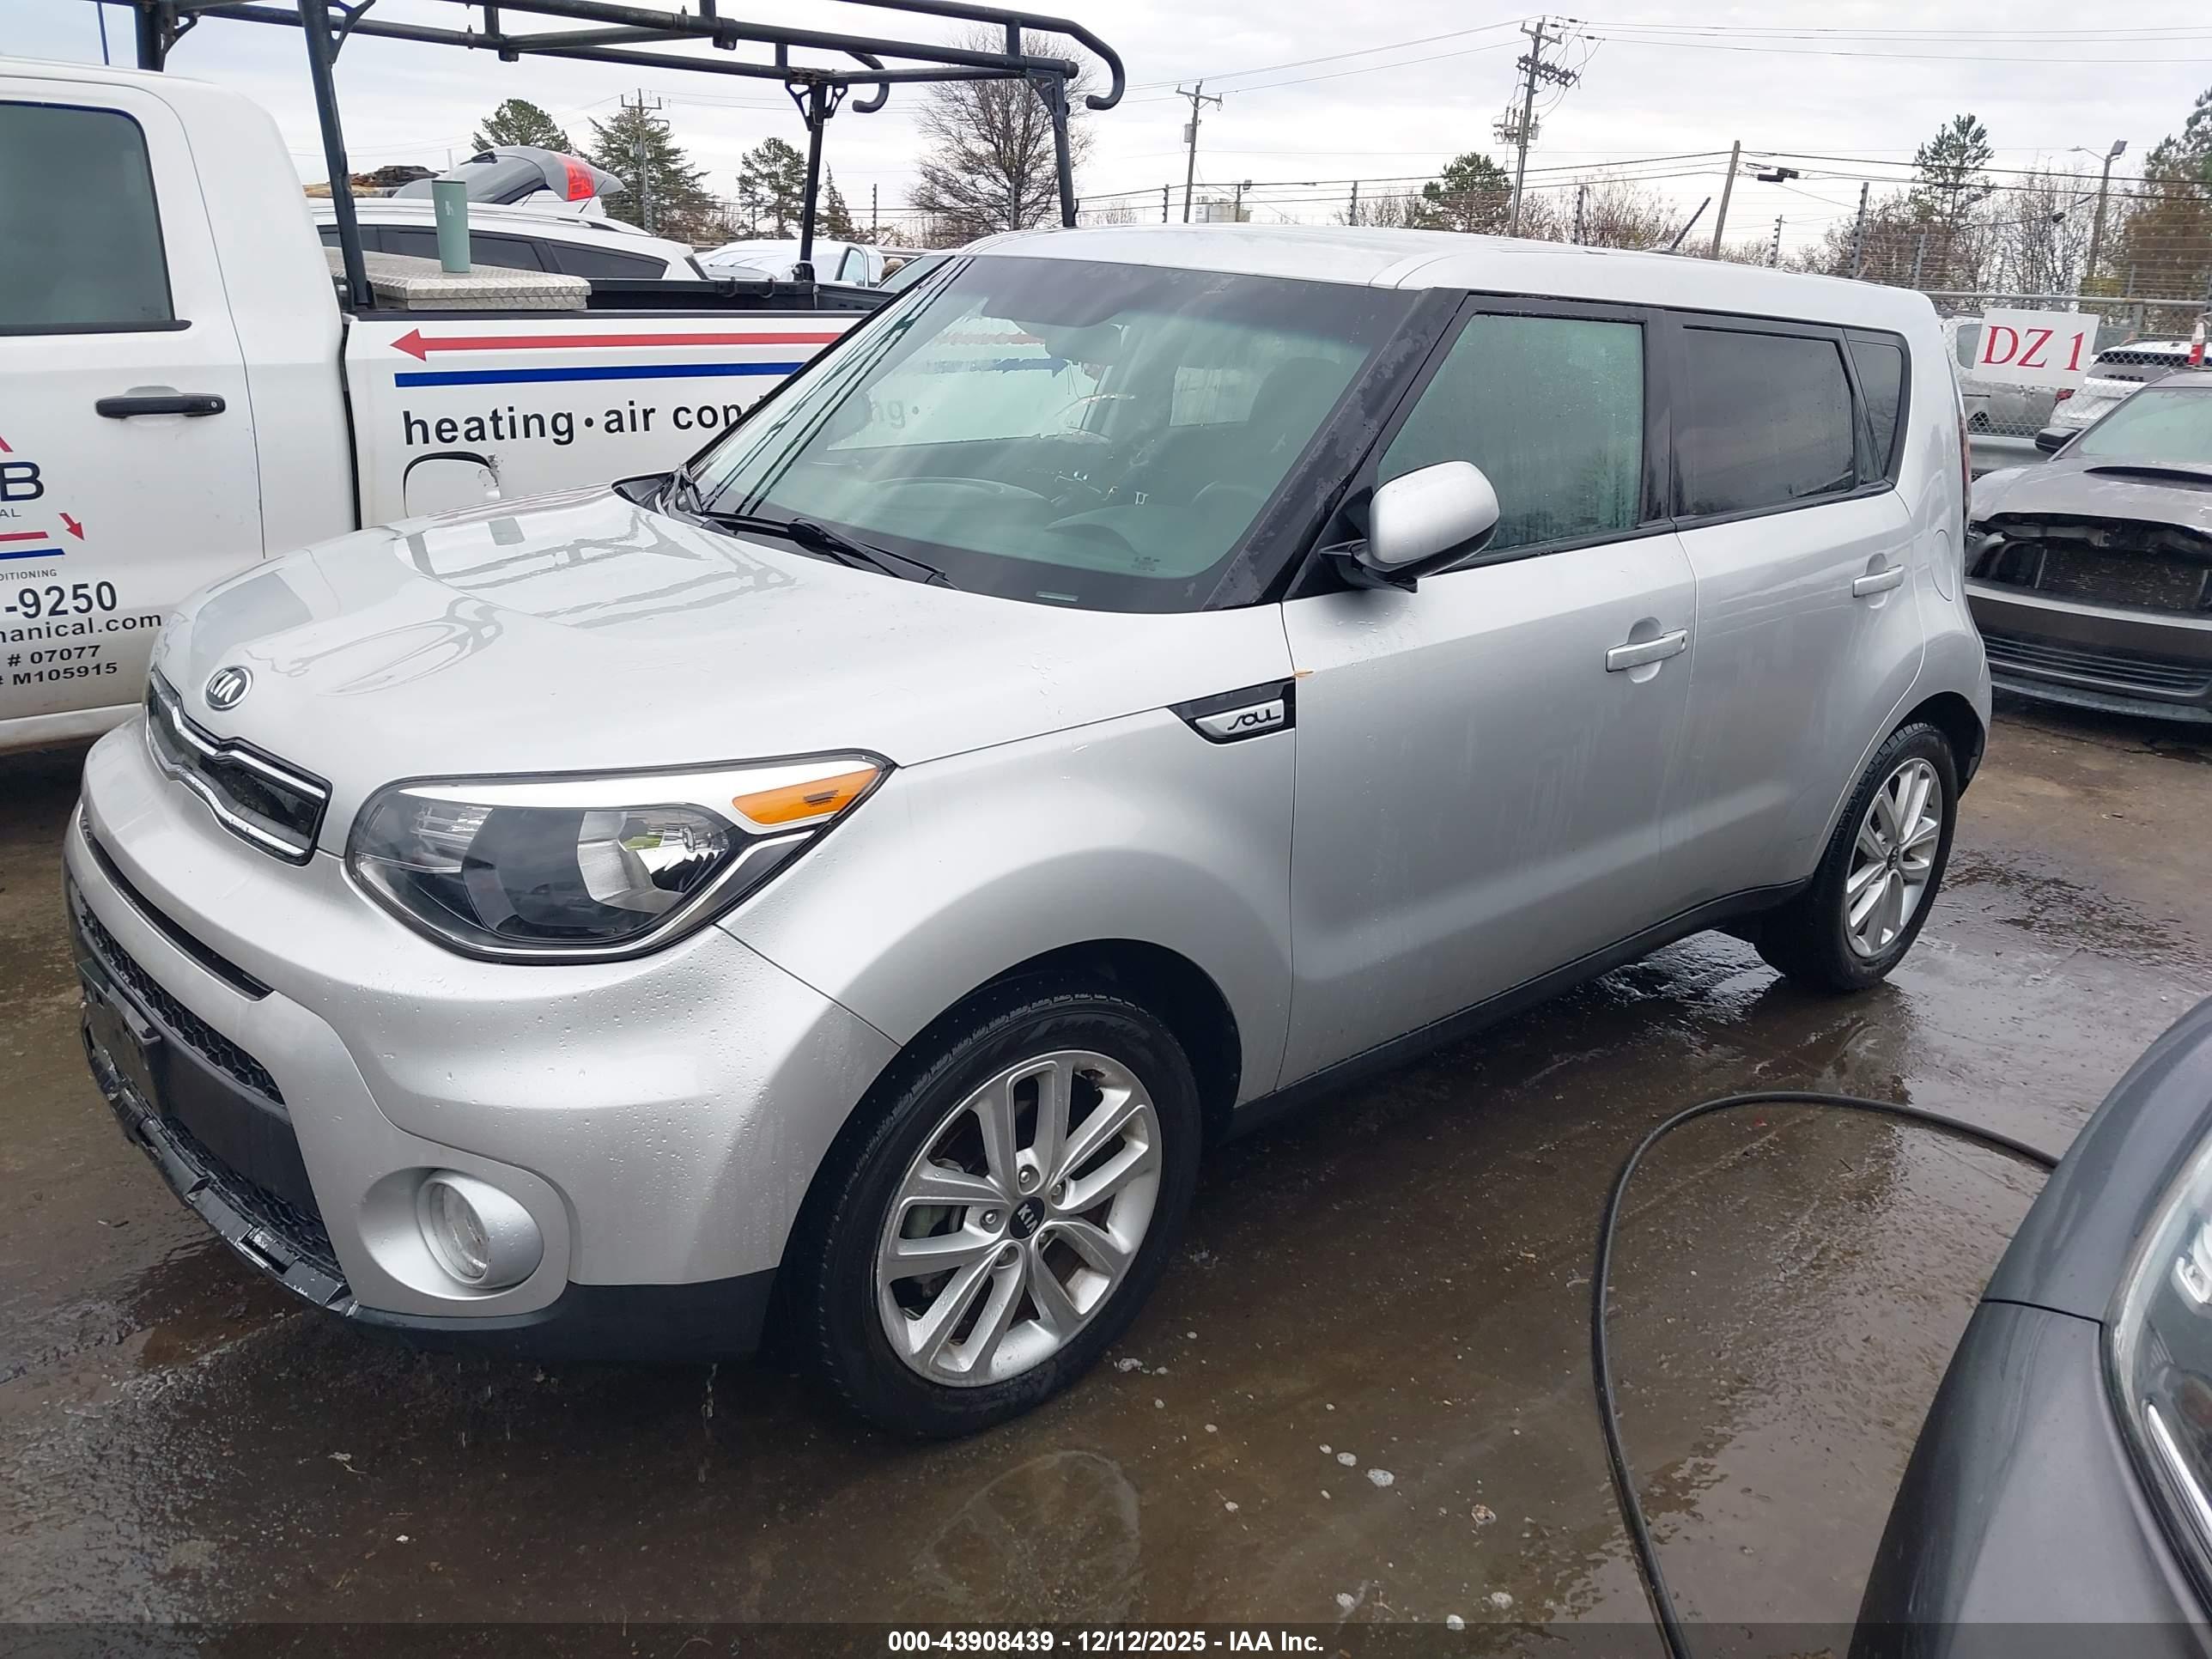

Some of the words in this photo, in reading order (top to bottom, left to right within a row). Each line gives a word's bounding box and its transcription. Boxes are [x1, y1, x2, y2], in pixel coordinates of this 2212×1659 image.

[1980, 325, 2054, 368] DZ
[2063, 332, 2085, 371] 1
[5, 580, 117, 619] -9250
[7, 653, 21, 666] #
[30, 645, 101, 665] 07077
[13, 662, 118, 686] M105915
[1017, 1203, 1038, 1234] KIA
